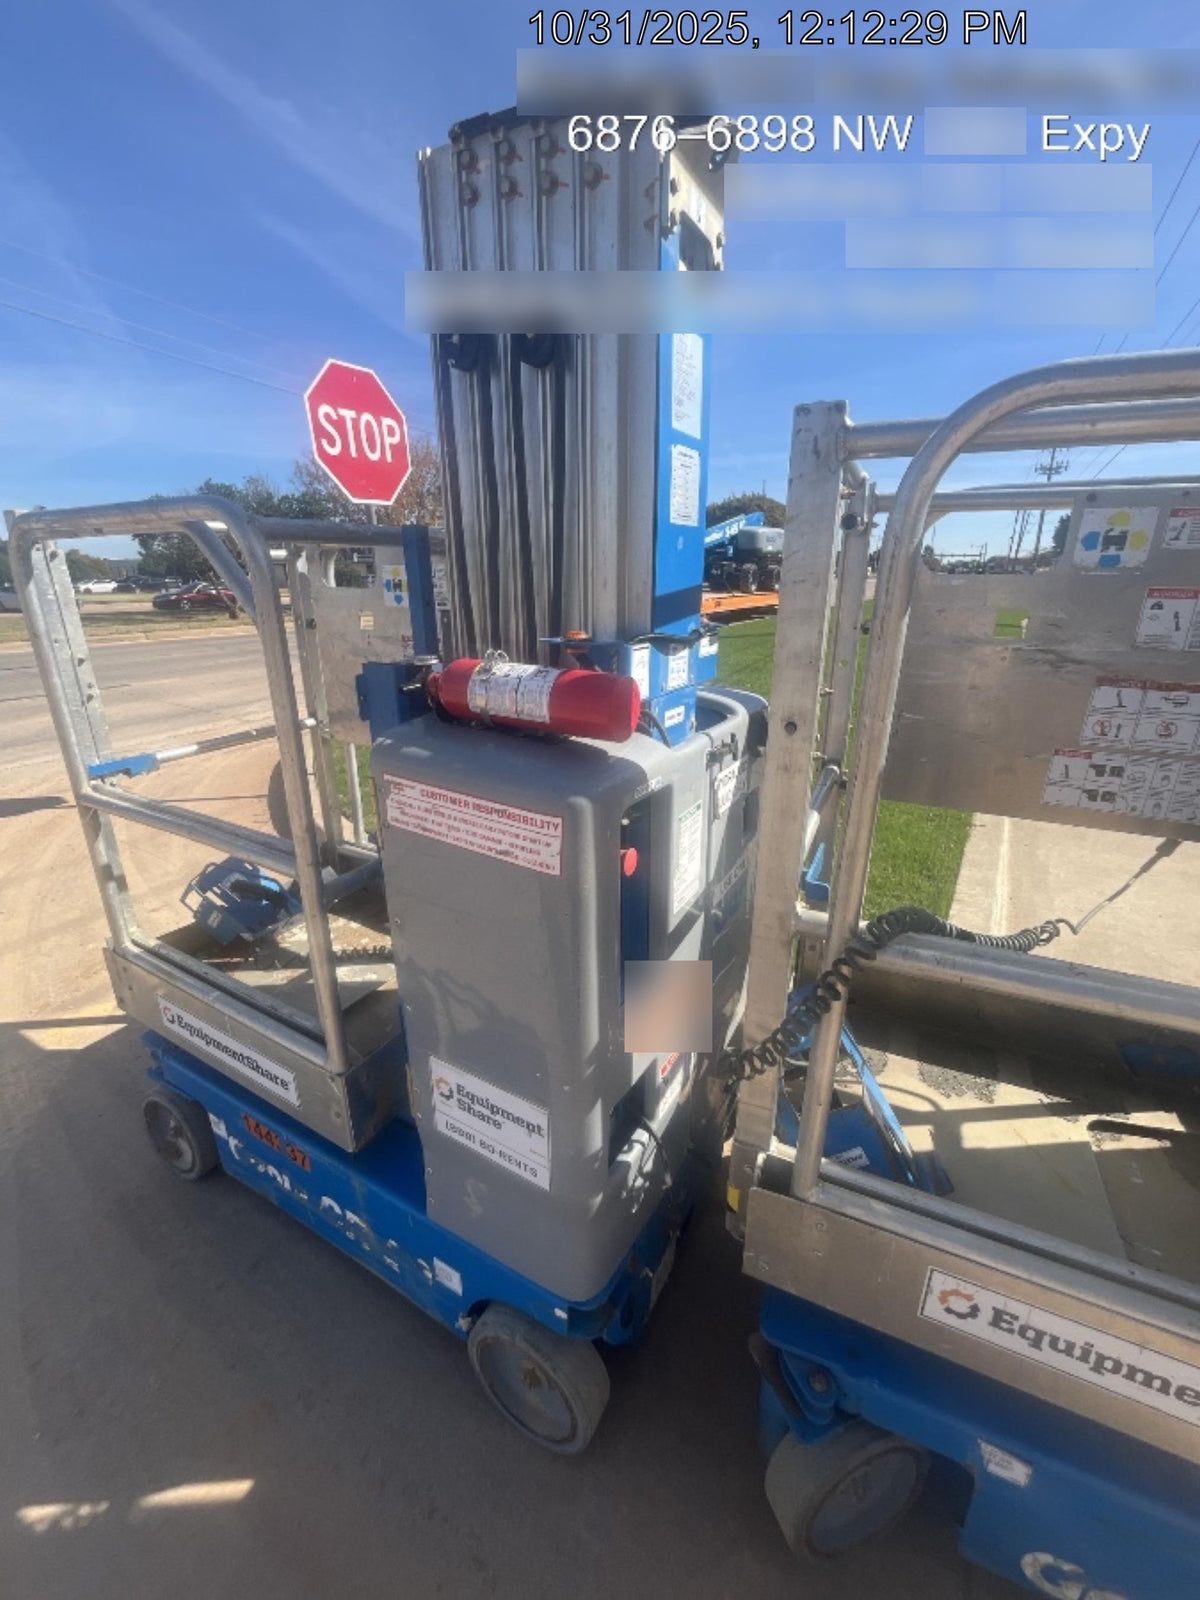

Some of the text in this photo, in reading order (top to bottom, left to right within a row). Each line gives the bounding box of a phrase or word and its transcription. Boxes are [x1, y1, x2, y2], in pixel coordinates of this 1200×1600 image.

[317, 403, 401, 463] STOP
[420, 788, 470, 810] CUSTOMER
[472, 801, 560, 832] RESPONSIBILITY
[456, 1082, 545, 1139] Equipment
[457, 1098, 502, 1131] Share
